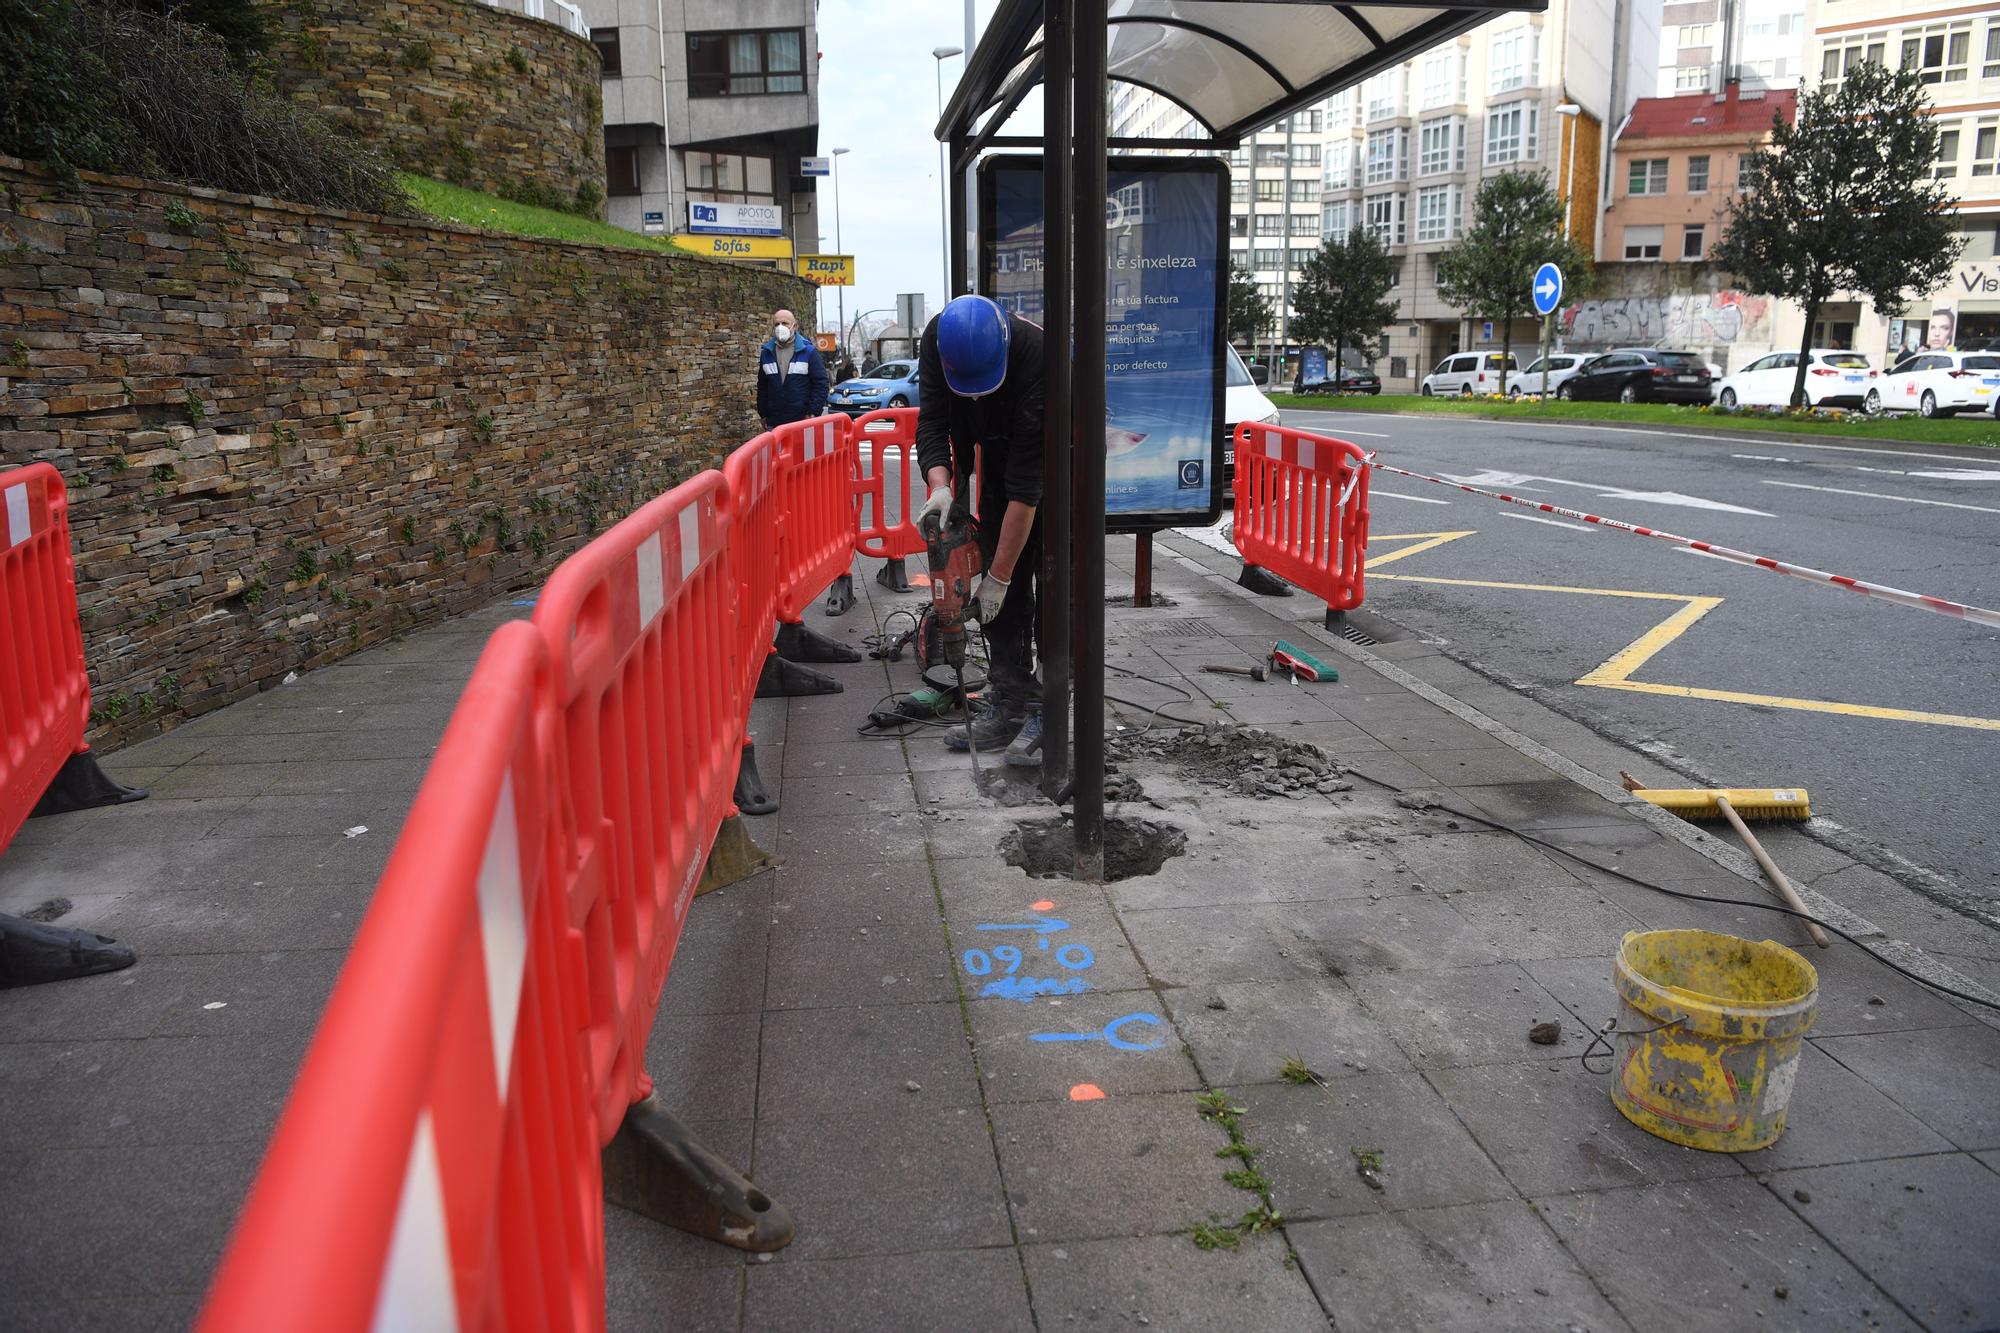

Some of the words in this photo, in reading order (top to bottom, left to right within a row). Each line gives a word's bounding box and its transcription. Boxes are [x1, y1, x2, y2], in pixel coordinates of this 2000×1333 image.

[738, 207, 775, 219] APOSTOL
[714, 239, 751, 255] Sofás
[808, 258, 845, 273] Rapi
[1130, 254, 1197, 269] sinxeleza
[1960, 271, 2000, 293] Vis
[1112, 297, 1125, 306] na
[1127, 295, 1142, 306] túa
[1144, 294, 1179, 304] factura
[1120, 322, 1160, 333] persoas,
[1109, 334, 1155, 346] máquinas
[1113, 363, 1130, 373] por
[1132, 359, 1168, 370] defecto
